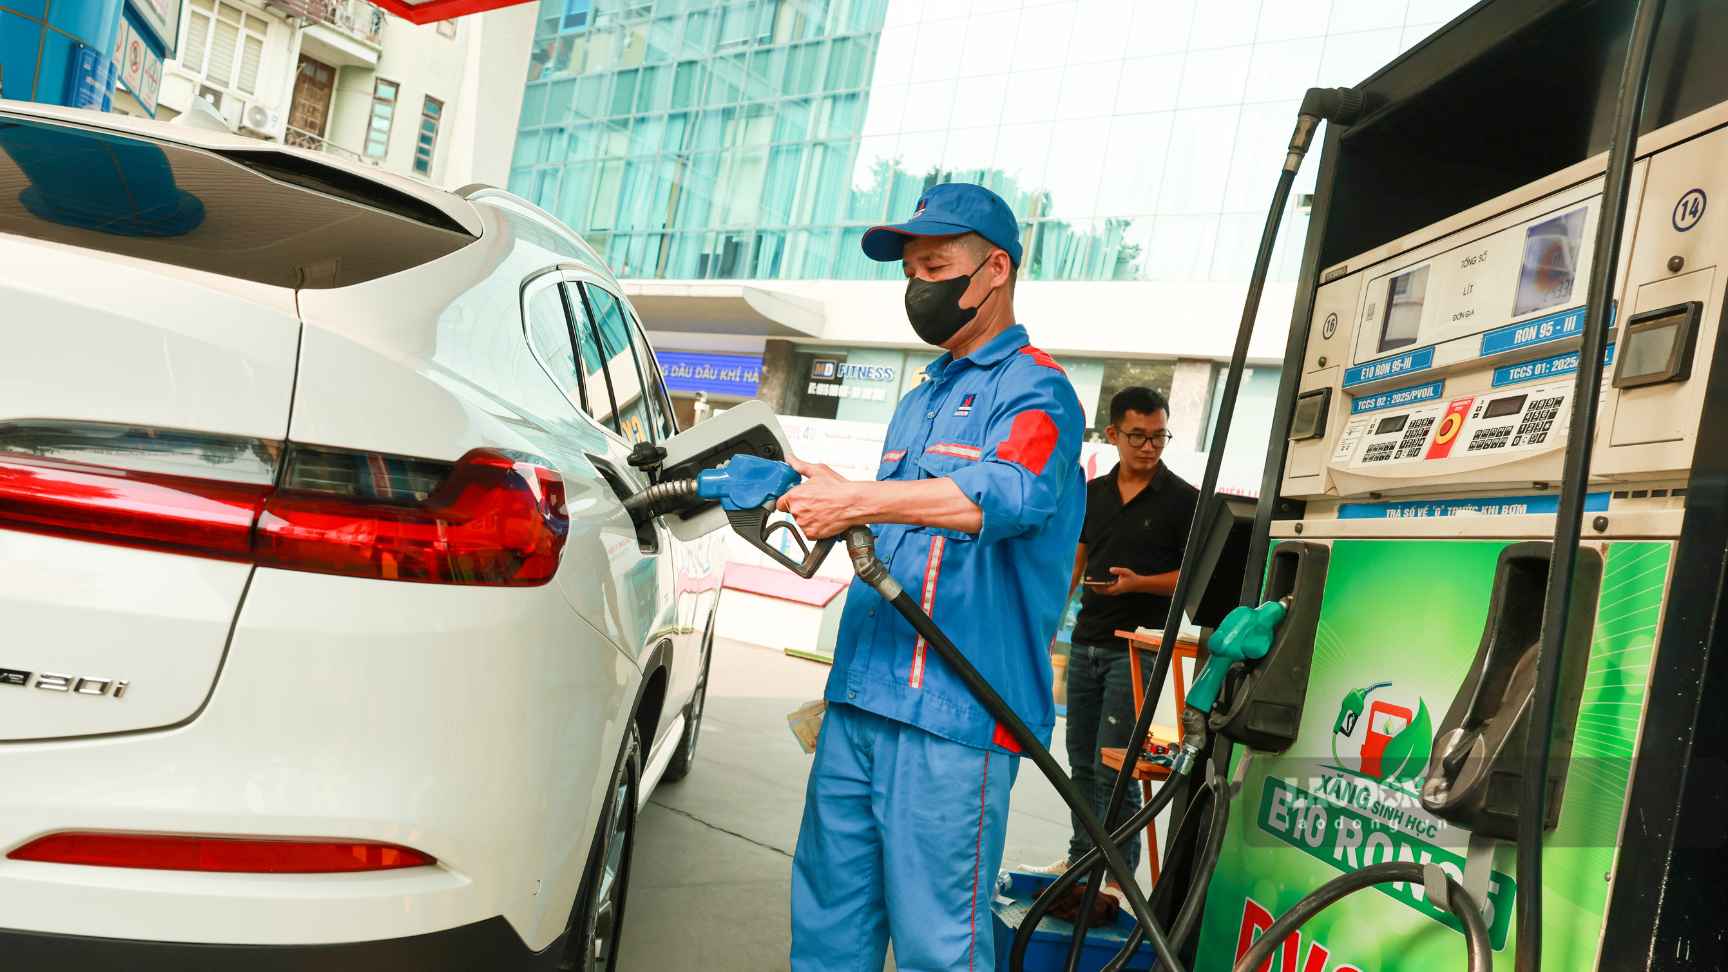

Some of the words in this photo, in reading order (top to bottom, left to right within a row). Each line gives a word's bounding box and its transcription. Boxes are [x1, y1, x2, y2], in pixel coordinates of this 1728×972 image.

[1681, 197, 1700, 222] 14
[1514, 324, 1538, 344] RON
[1539, 321, 1554, 338] 95
[1563, 315, 1577, 332] III
[837, 362, 895, 382] FITNESS
[1360, 366, 1374, 380] E10
[1375, 361, 1391, 376] RON
[1509, 366, 1533, 380] TCCS
[1358, 399, 1376, 410] TCCS
[1313, 772, 1371, 810] XĂNG
[1371, 800, 1404, 825] SINH
[1406, 814, 1437, 838] HỌC
[1268, 786, 1328, 849] E10
